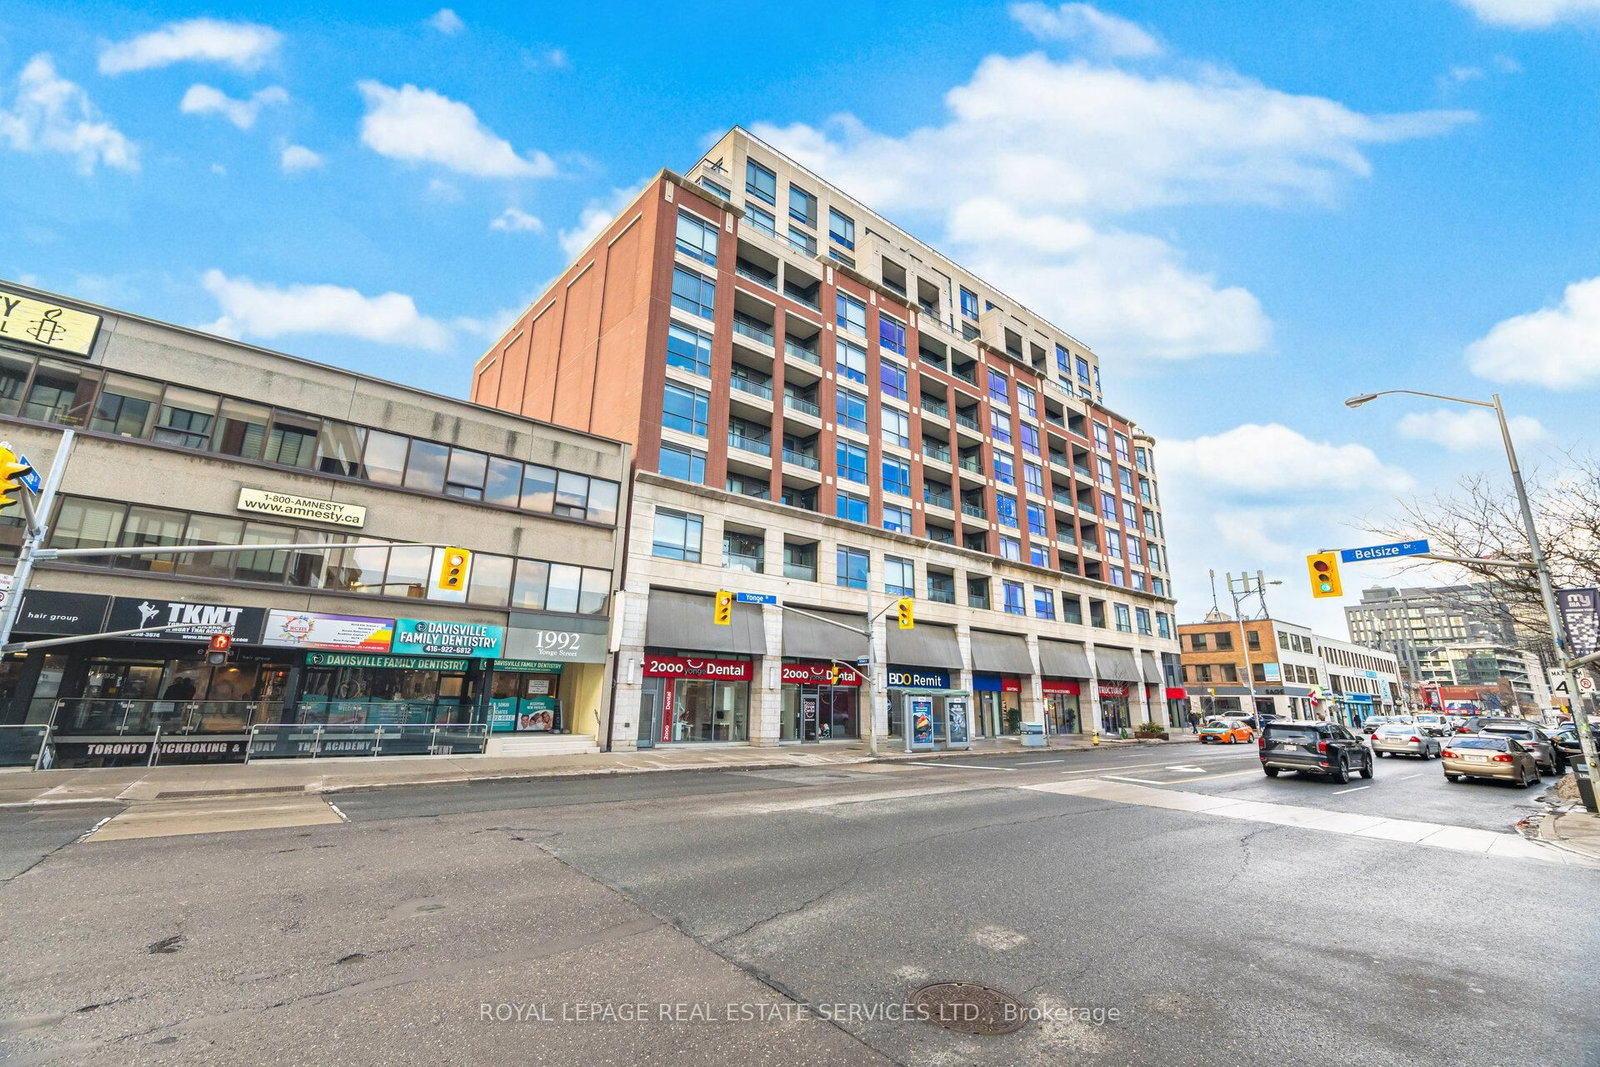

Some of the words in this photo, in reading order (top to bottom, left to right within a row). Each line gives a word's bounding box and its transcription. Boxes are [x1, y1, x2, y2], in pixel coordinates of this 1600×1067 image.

[0, 296, 21, 317] Y
[264, 494, 345, 512] 1-800-AMNESTY
[245, 500, 360, 523] www.amnesty.ca
[1355, 546, 1400, 559] Belsize
[746, 594, 764, 603] Yonge
[50, 614, 79, 622] group
[167, 603, 243, 625] TKMT
[428, 622, 487, 637] DAVISVILLE
[400, 631, 440, 646] FAMILY
[441, 633, 498, 648] DENTISTRY
[535, 631, 581, 650] 1992
[425, 645, 472, 654] 416-922-6812
[538, 649, 559, 657] Yonge
[326, 655, 382, 667] DAVISVILLE
[383, 657, 416, 669] FAMILY
[417, 659, 465, 670] DENTISTRY
[494, 659, 521, 667] DAVISVILLE
[684, 668, 707, 676] yonge
[706, 663, 744, 676] Dental
[826, 670, 856, 681] Dntal
[888, 672, 912, 686] BDO
[913, 674, 942, 687] Remit
[87, 743, 147, 755] TORONTO
[231, 744, 240, 752] &
[324, 741, 371, 751] ACADEMY
